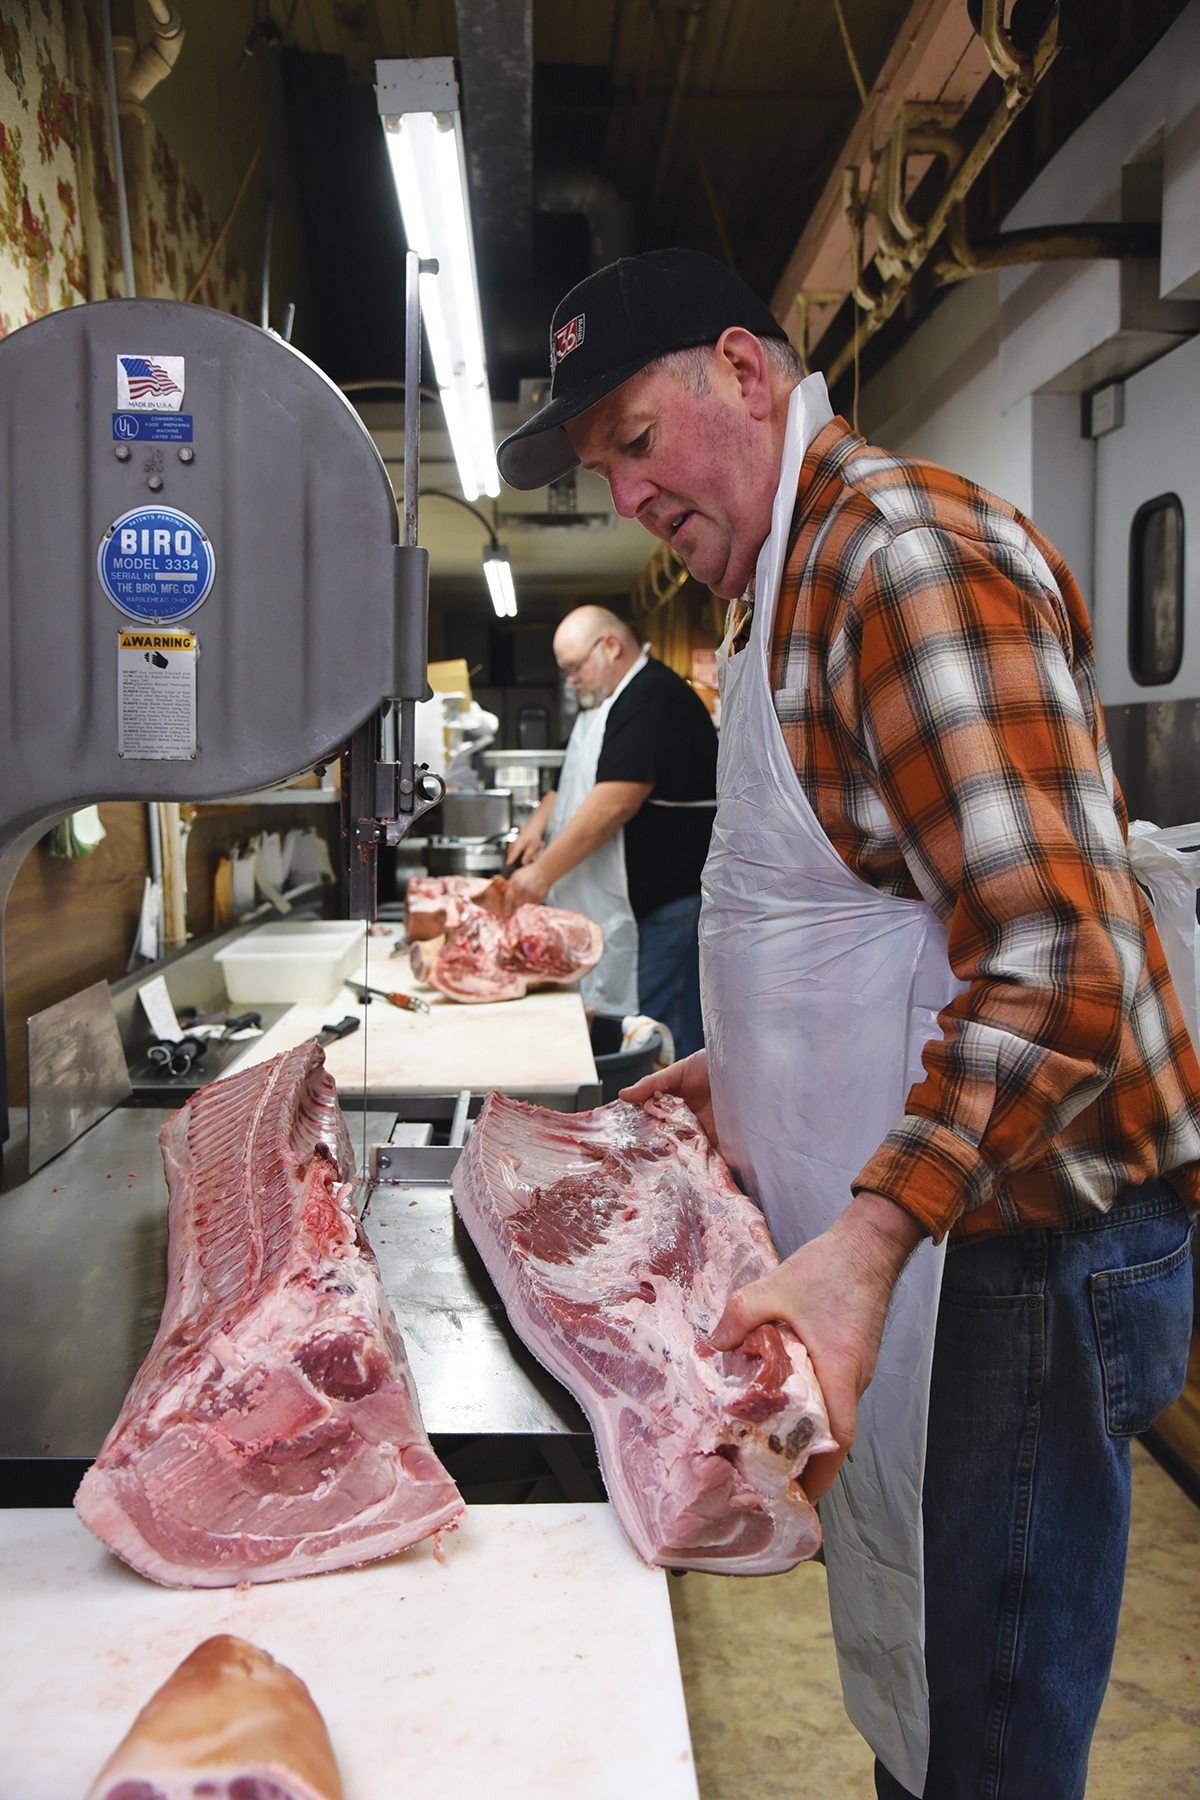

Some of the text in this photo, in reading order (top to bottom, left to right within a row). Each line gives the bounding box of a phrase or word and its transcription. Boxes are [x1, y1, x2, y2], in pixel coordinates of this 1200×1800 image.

[557, 322, 577, 357] 36
[119, 418, 135, 437] UL
[128, 514, 184, 528] PATENTS PENDING
[120, 528, 192, 556] BIRO
[113, 558, 199, 571] MODEL 3334
[111, 572, 141, 580] SERIAL
[117, 582, 133, 593] THE
[161, 583, 181, 594] MFG.
[183, 584, 197, 595] CO.
[136, 605, 158, 615] SINCE
[131, 636, 191, 648] WARNING
